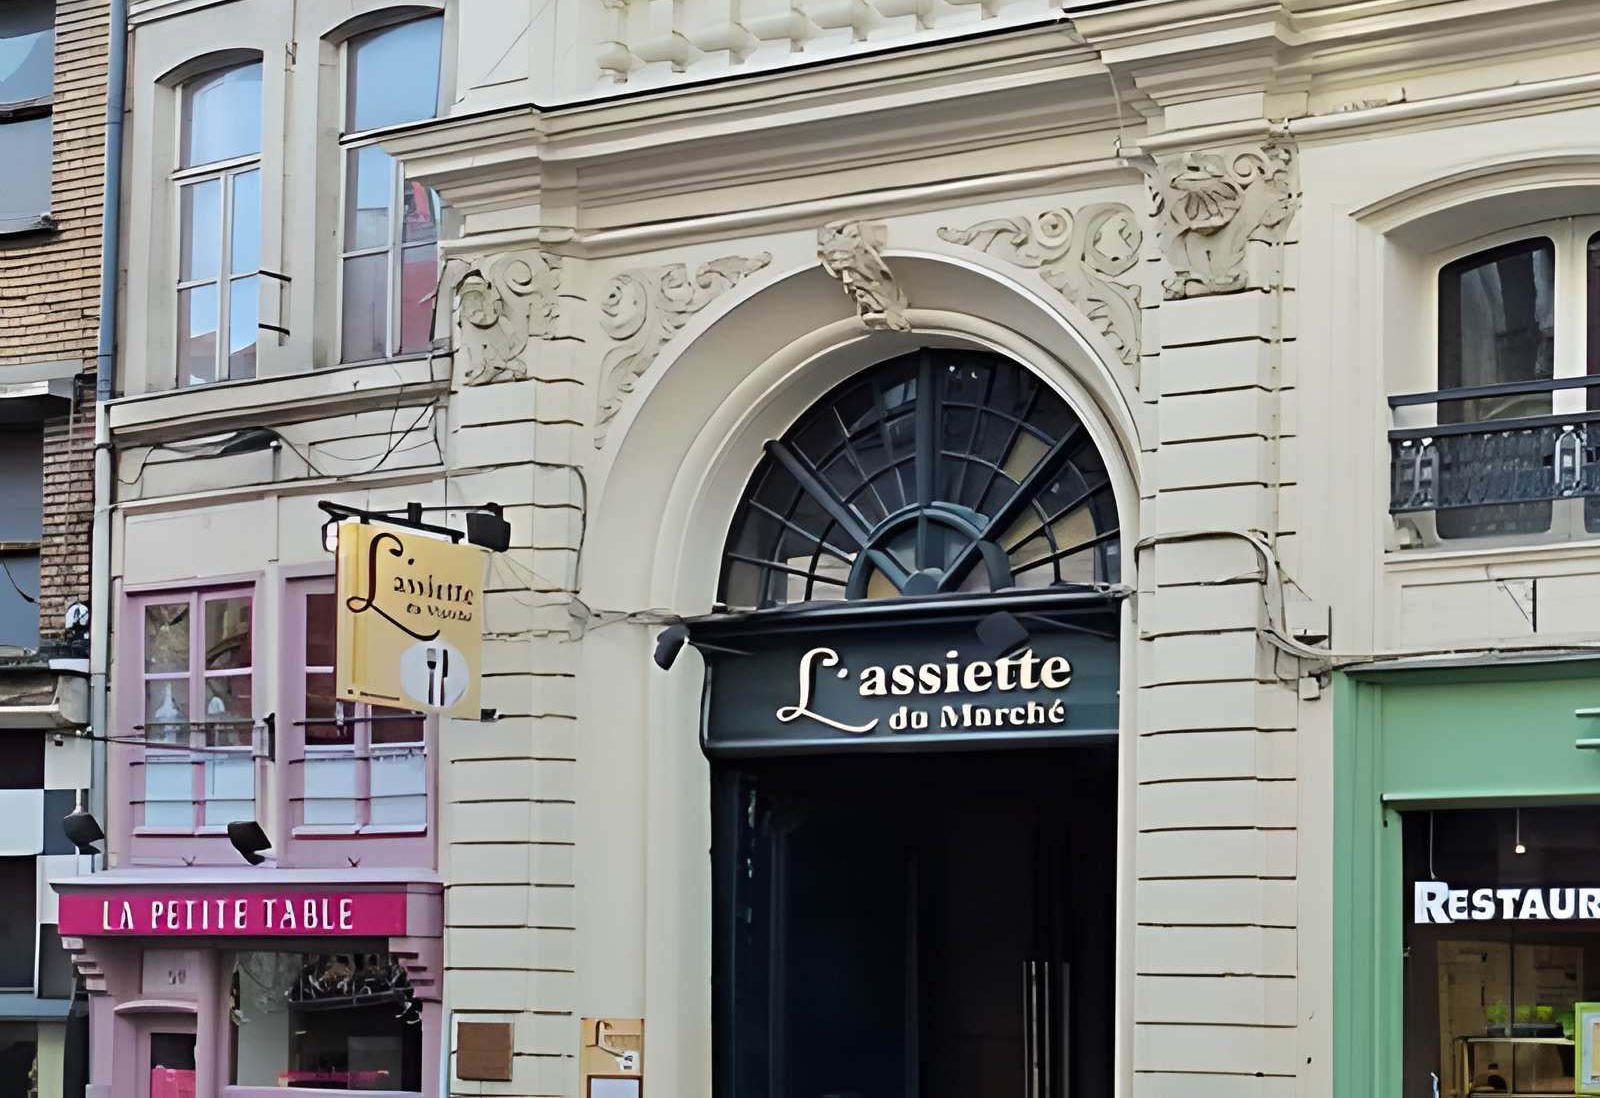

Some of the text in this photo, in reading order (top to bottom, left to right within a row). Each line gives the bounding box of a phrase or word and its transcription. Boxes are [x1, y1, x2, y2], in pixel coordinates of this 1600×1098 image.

[775, 646, 1072, 733] L'assiette
[939, 698, 1066, 729] Marché
[102, 897, 354, 931] LA PETITE TABLE
